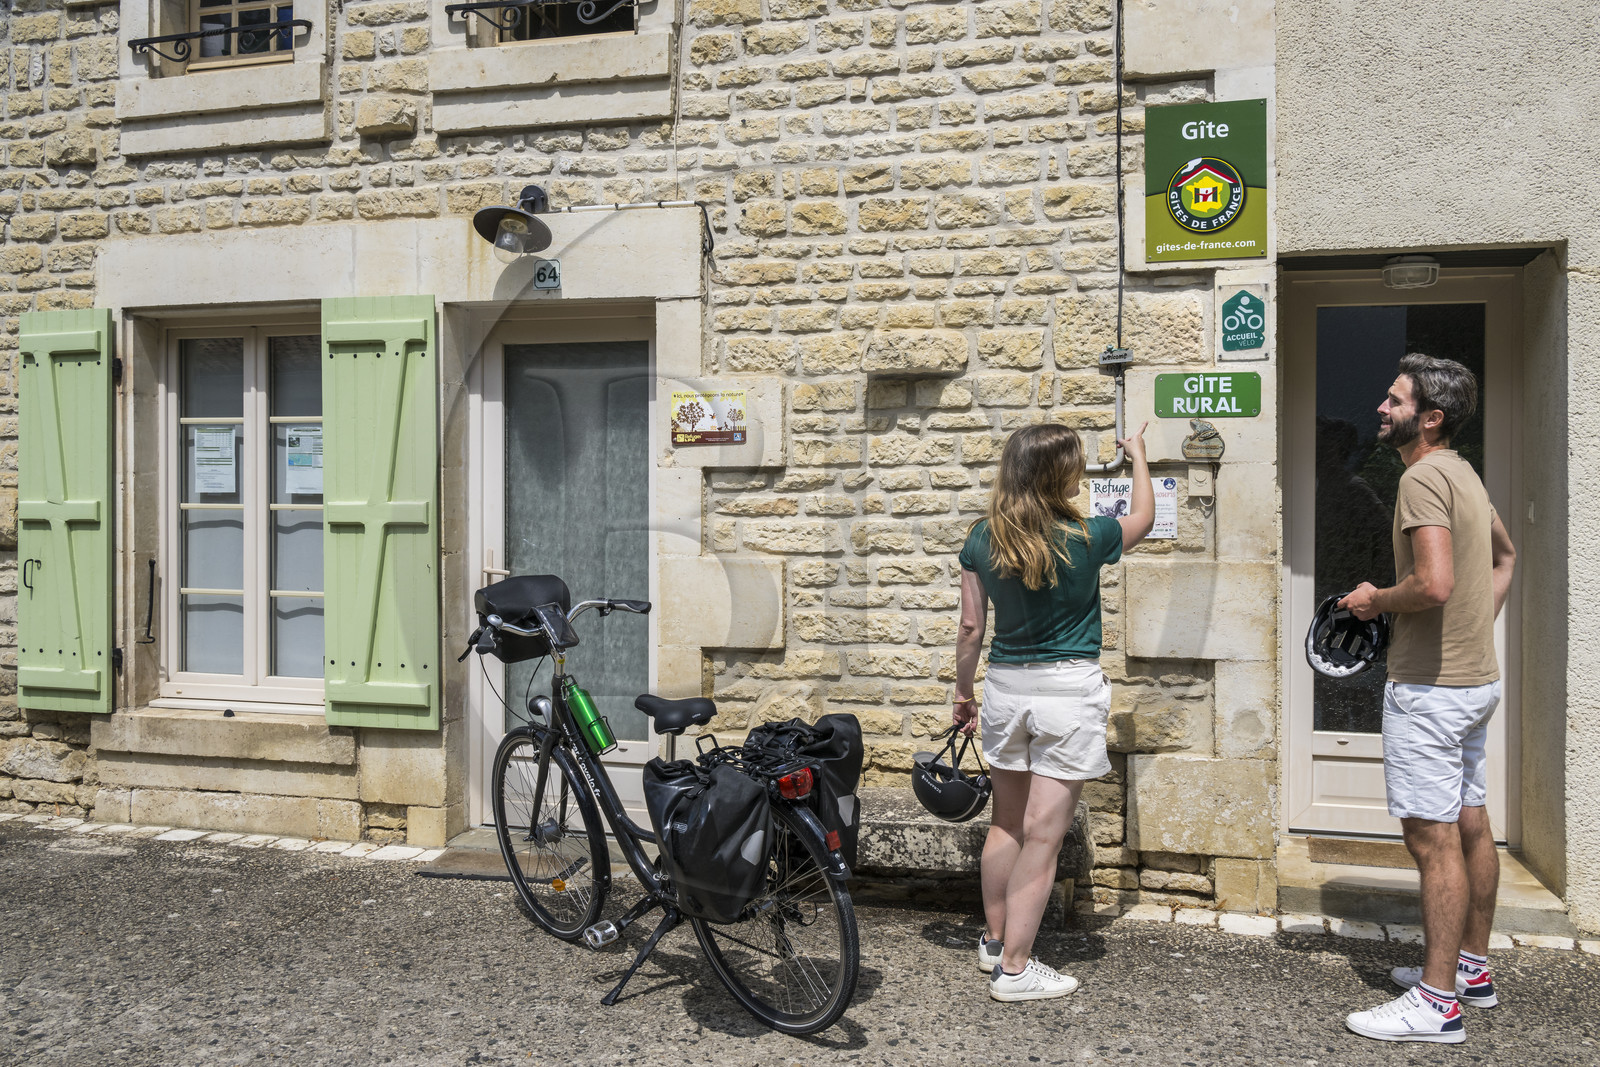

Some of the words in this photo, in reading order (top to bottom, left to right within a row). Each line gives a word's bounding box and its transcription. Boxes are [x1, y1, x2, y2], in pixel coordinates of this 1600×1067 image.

[1181, 120, 1229, 140] Gîte
[1191, 221, 1207, 229] DE
[1212, 186, 1241, 228] FRANCE
[1156, 239, 1256, 254] gites-de-france.com
[536, 266, 558, 283] 64
[1226, 332, 1258, 342] ACCUEIL
[1239, 338, 1255, 347] VÉLO
[1183, 374, 1232, 394] GÎTE
[1173, 396, 1242, 414] RURAL
[1094, 479, 1130, 497] Refuge
[1457, 962, 1483, 976] ILA
